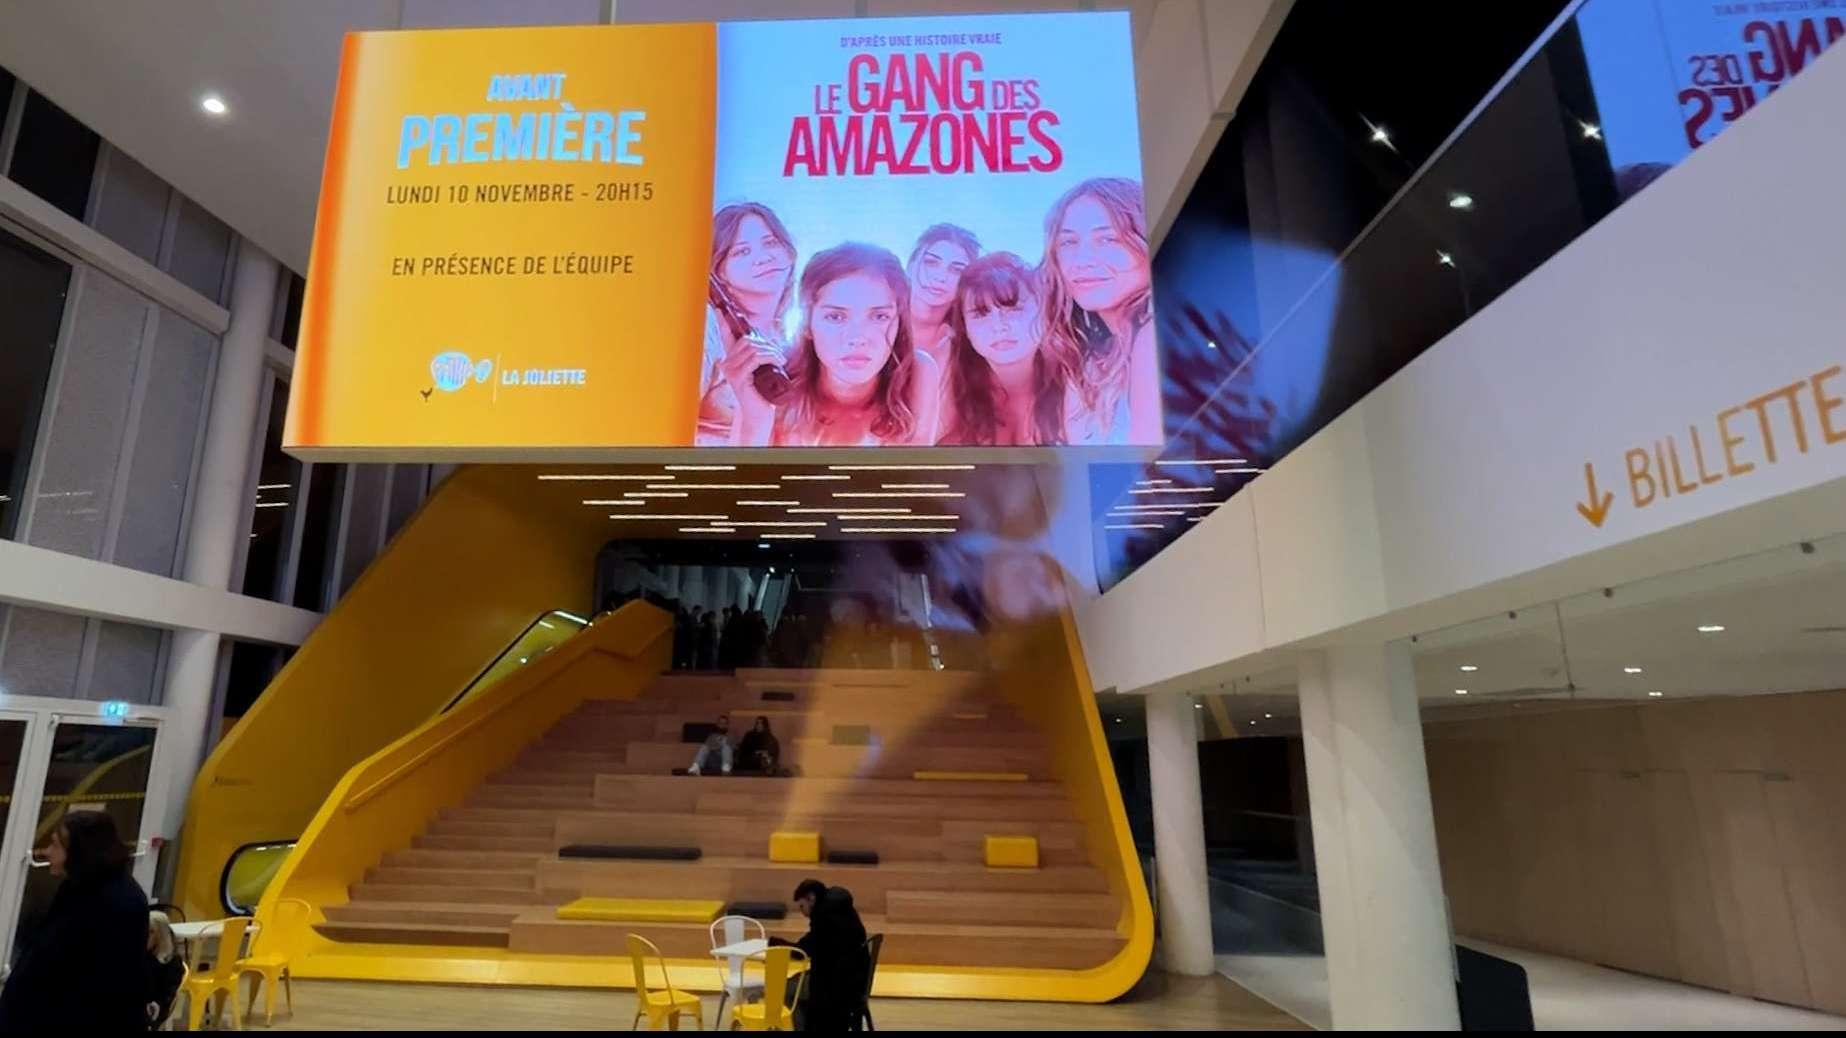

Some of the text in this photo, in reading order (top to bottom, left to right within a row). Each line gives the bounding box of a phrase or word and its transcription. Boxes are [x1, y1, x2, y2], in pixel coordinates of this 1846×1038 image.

[889, 35, 912, 47] UNE
[914, 33, 967, 47] HISTOIRE
[969, 32, 1003, 45] VRAIE
[486, 73, 567, 102] AVANT
[814, 50, 1041, 115] LE GANG DES
[396, 102, 646, 169] PREMIÈRE
[783, 110, 1064, 177] AMAZONES
[387, 184, 441, 204] LUNDI
[448, 184, 469, 204] 10
[475, 183, 575, 203] NOVEMBRE
[595, 181, 654, 202] 20H15
[392, 251, 634, 276] EN PRÉSENCE DE L'ÉQUIPE
[502, 369, 520, 386] LA
[523, 368, 587, 386] JOLIETTE
[1625, 365, 1846, 509] BILLETTE
